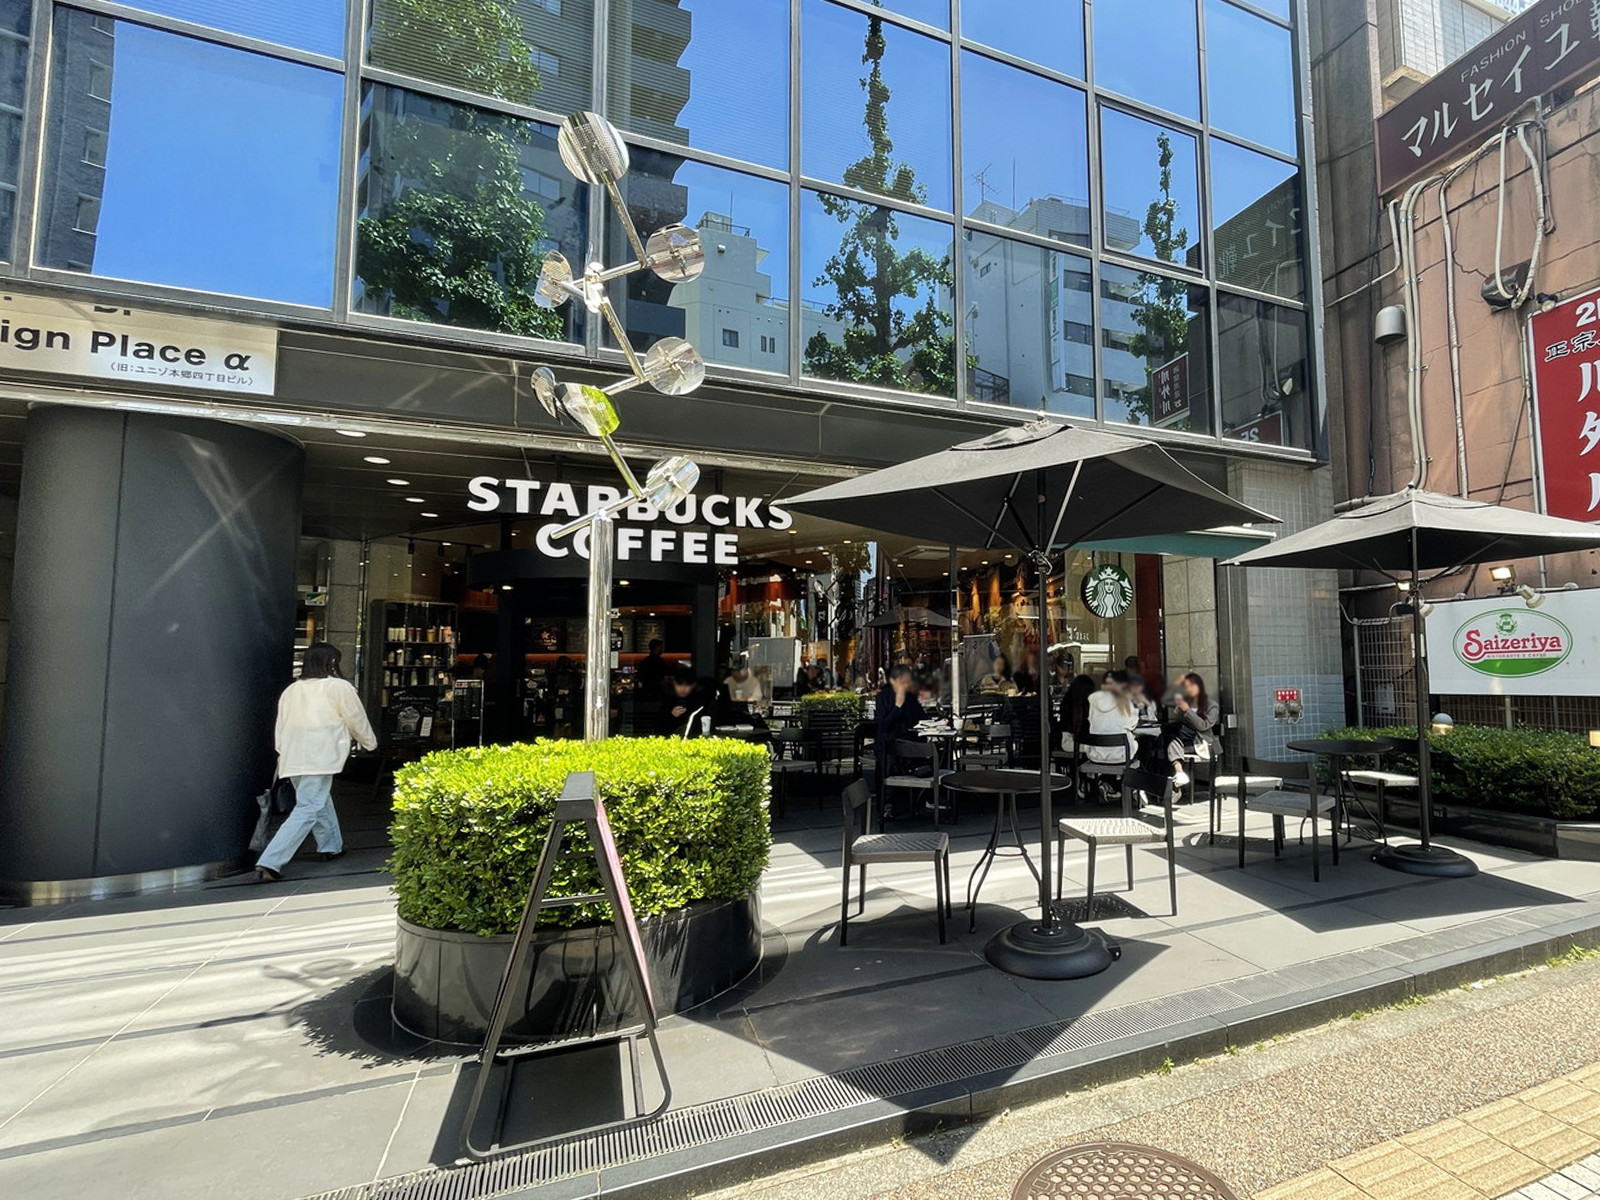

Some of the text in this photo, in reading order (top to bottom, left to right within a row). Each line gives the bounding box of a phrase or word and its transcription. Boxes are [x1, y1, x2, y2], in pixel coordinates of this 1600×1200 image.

[1461, 30, 1527, 82] FASHION
[1576, 298, 1600, 327] 2
[0, 320, 70, 352] ign
[92, 331, 206, 366] Place
[1544, 330, 1600, 362] 正宗
[1462, 629, 1562, 661] Saizeriya
